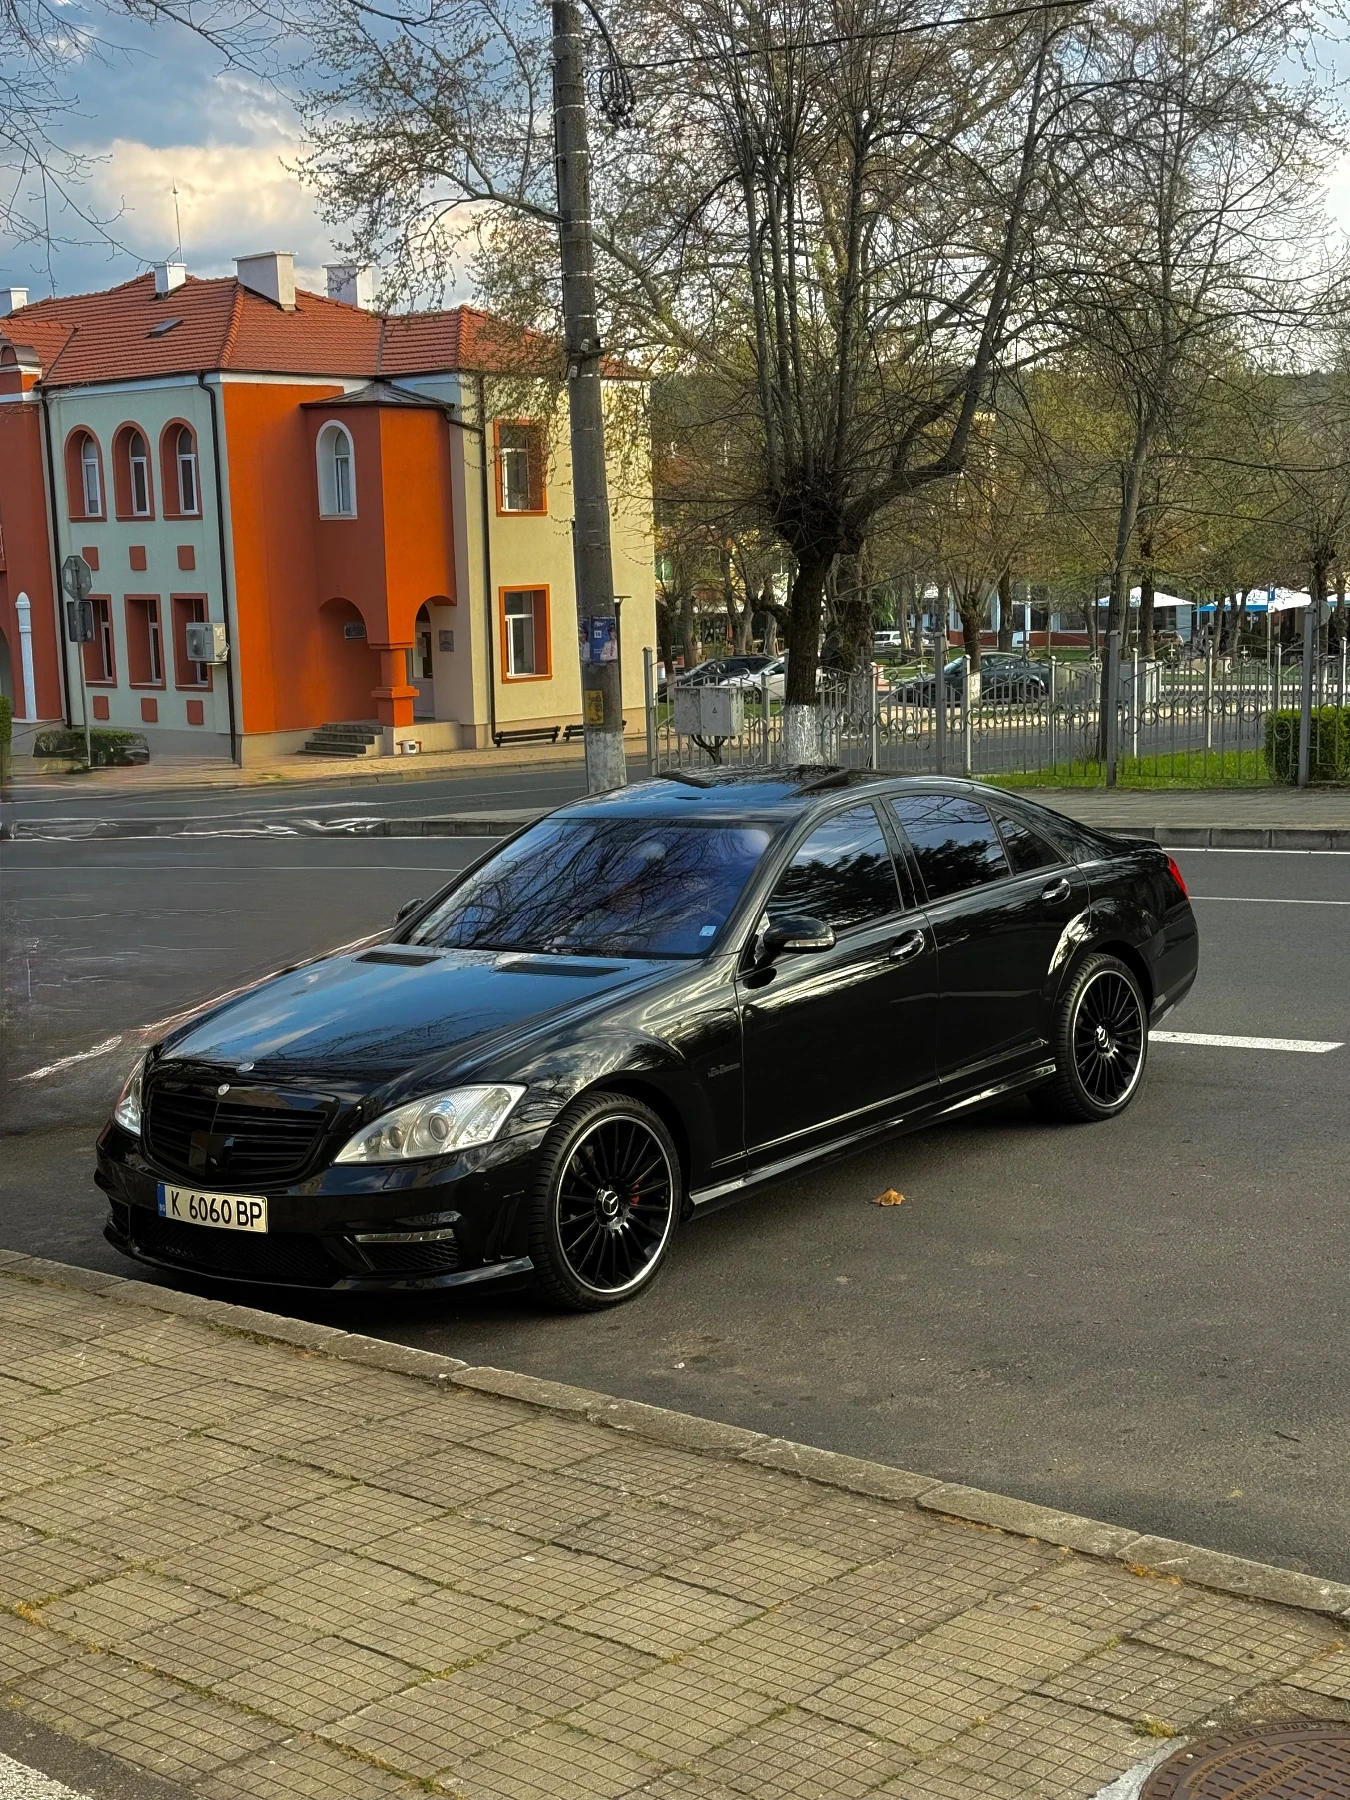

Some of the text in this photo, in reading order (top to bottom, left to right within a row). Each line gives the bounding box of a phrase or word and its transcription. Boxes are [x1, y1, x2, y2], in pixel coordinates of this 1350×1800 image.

[171, 1190, 262, 1227] K 6060 BP
